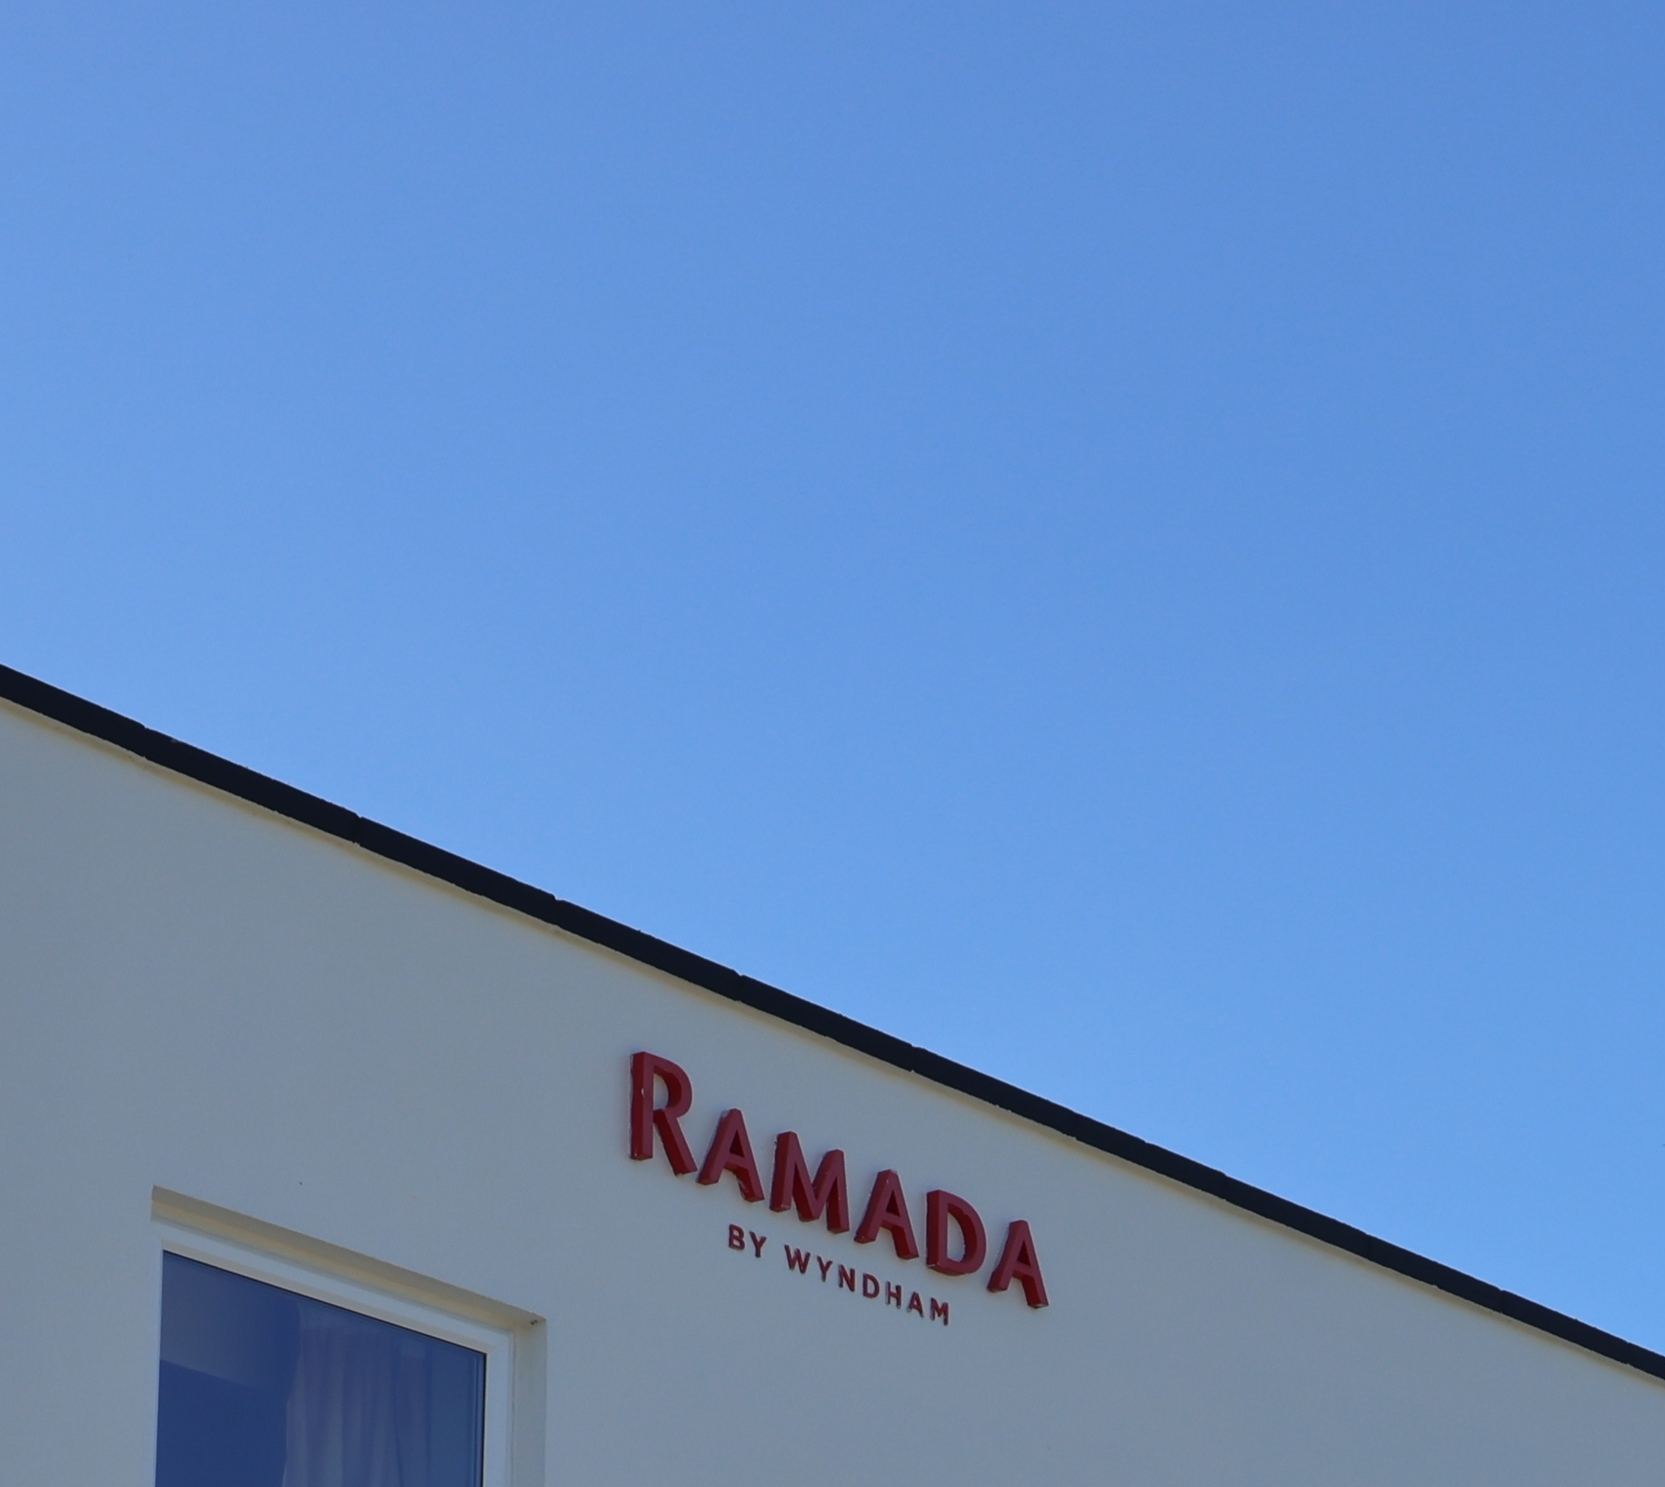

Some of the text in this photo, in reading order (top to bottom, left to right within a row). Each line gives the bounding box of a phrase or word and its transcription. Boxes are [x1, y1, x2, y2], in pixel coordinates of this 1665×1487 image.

[629, 1051, 1049, 1309] RAMADA
[728, 1223, 950, 1326] BY WYNDHAM
